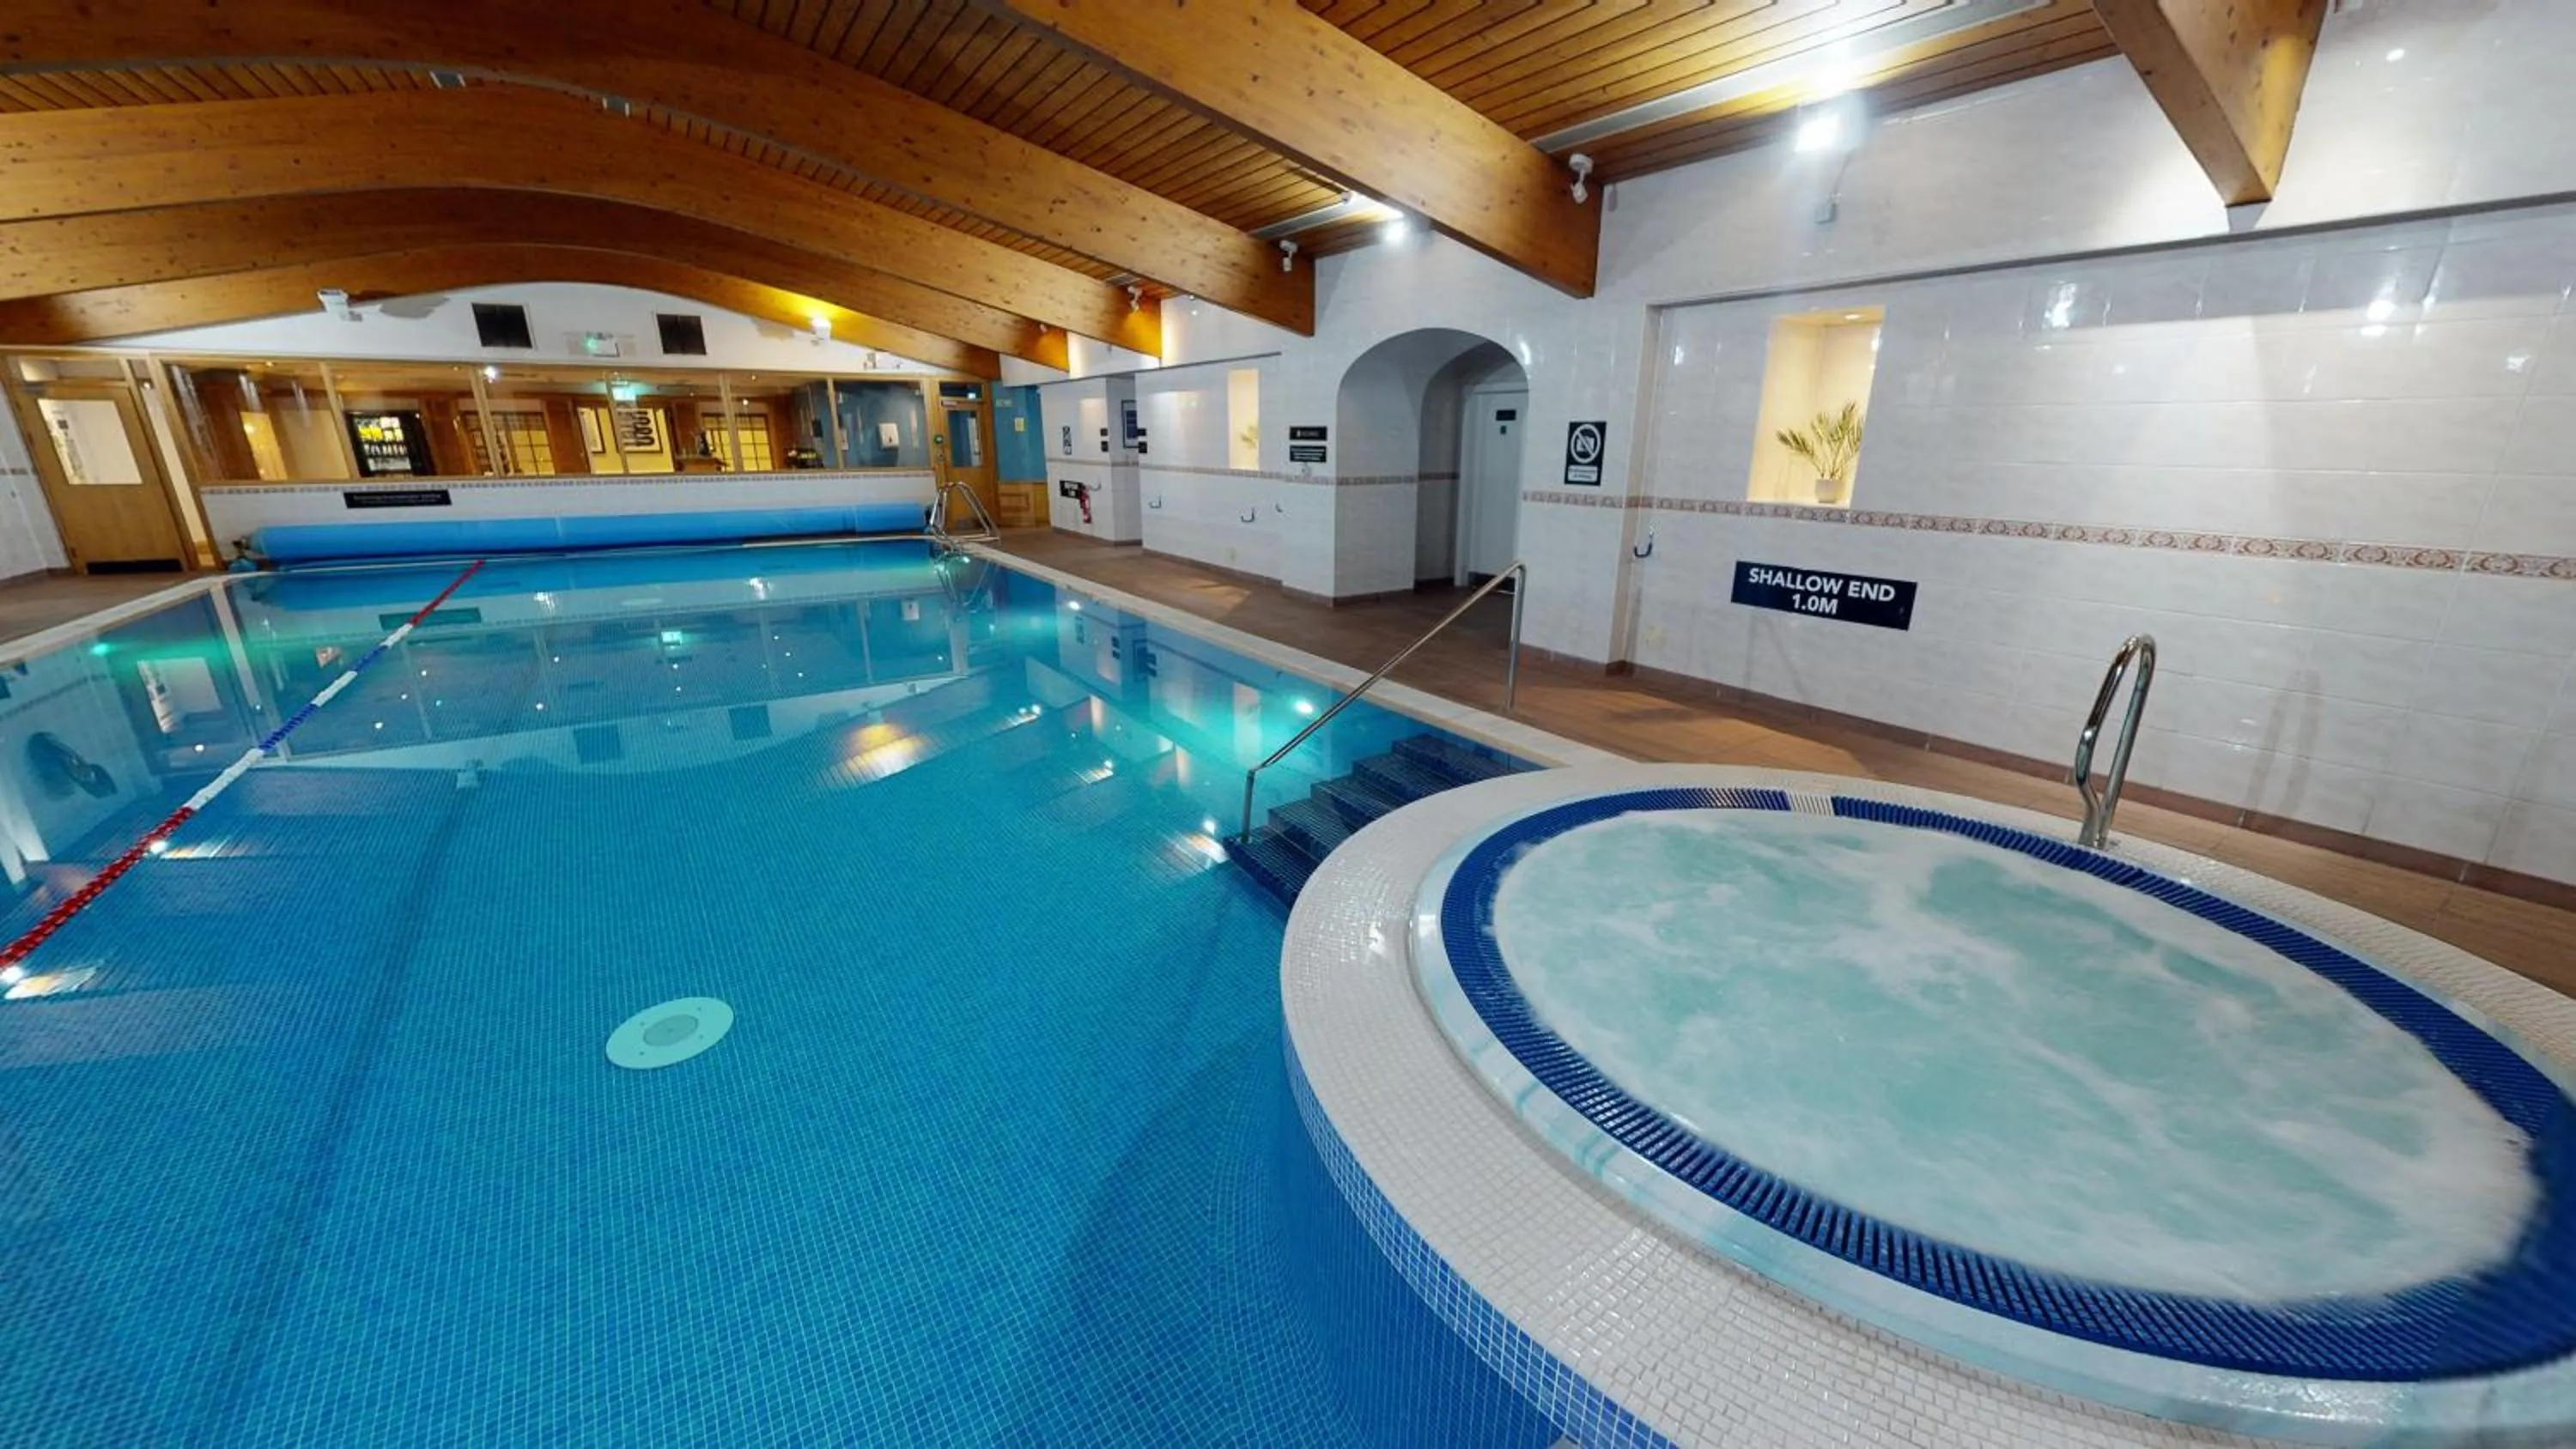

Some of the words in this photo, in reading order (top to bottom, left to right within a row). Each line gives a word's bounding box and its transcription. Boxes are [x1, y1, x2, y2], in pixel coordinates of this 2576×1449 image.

[1748, 567, 1843, 594] SHALLOW
[1848, 580, 1895, 602] END
[1792, 593, 1838, 615] 1.0M
